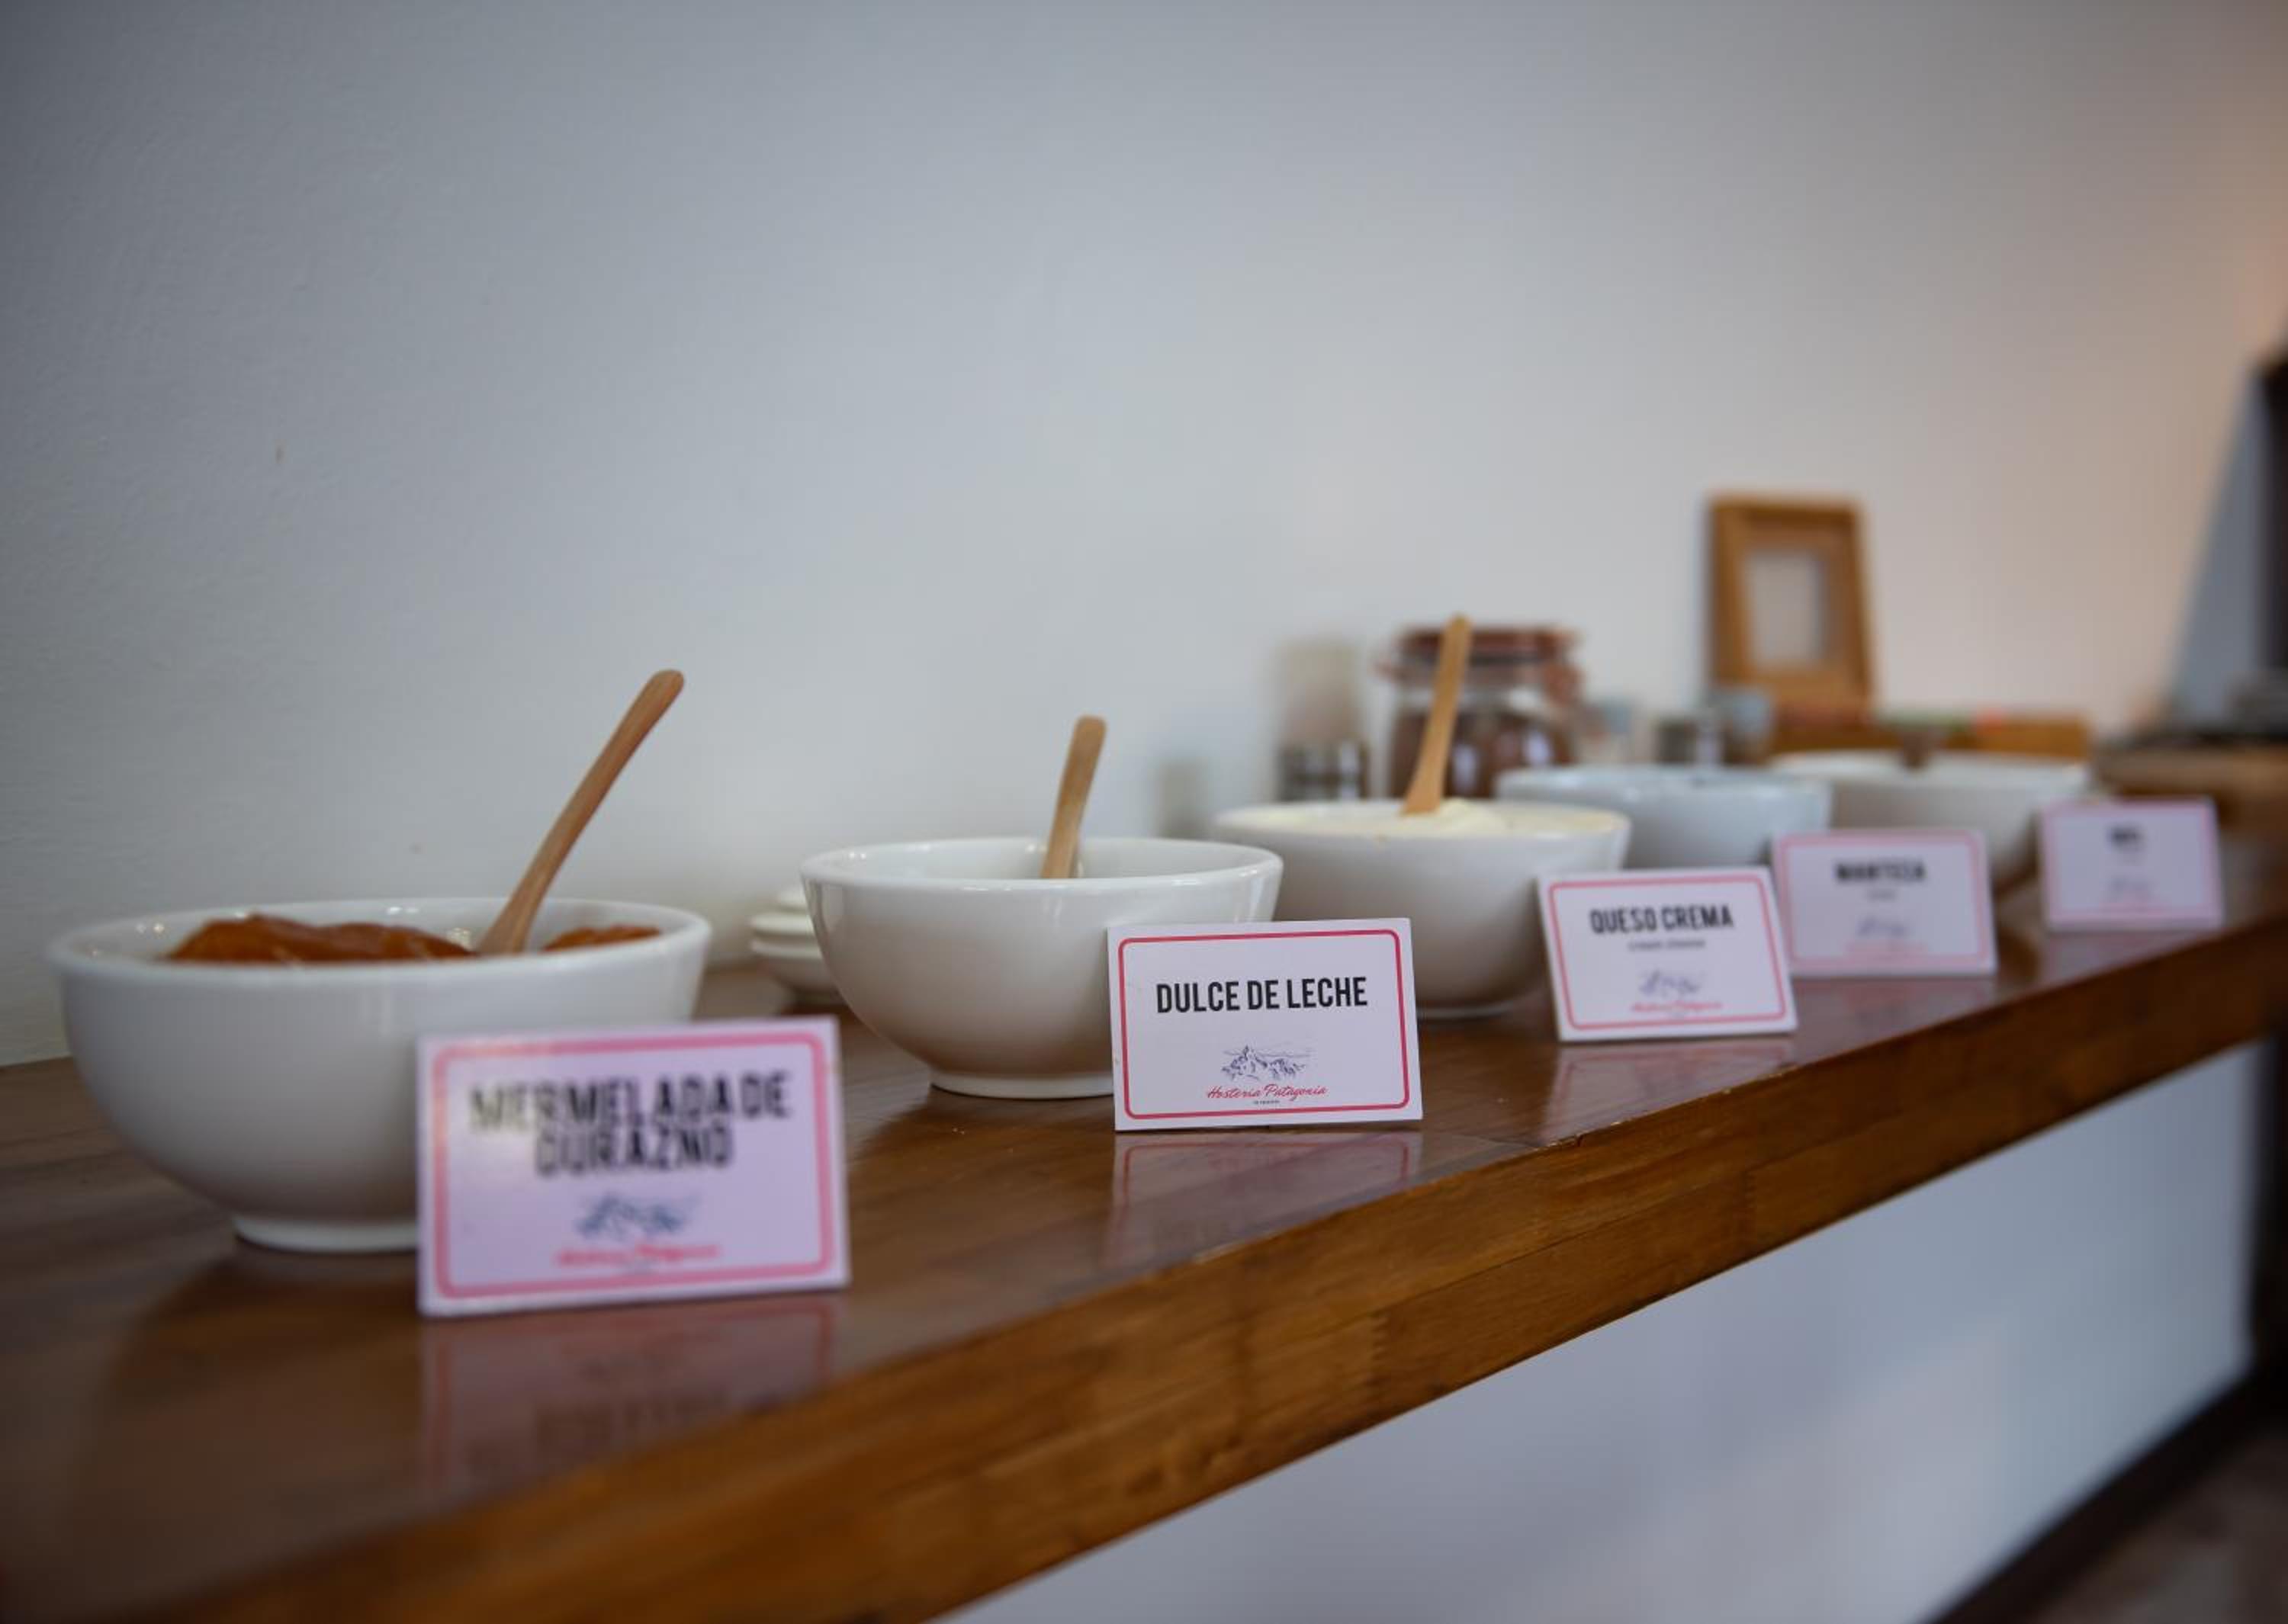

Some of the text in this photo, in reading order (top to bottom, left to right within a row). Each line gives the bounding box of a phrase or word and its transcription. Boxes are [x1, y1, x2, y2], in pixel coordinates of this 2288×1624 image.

[1589, 904, 1734, 934] QUESO CREMA
[1157, 976, 1368, 1013] DULCE DE LECHE
[472, 1071, 789, 1128] MERMELADA DE
[1263, 1083, 1327, 1102] Patagonia
[536, 1125, 733, 1176] DURAZNO
